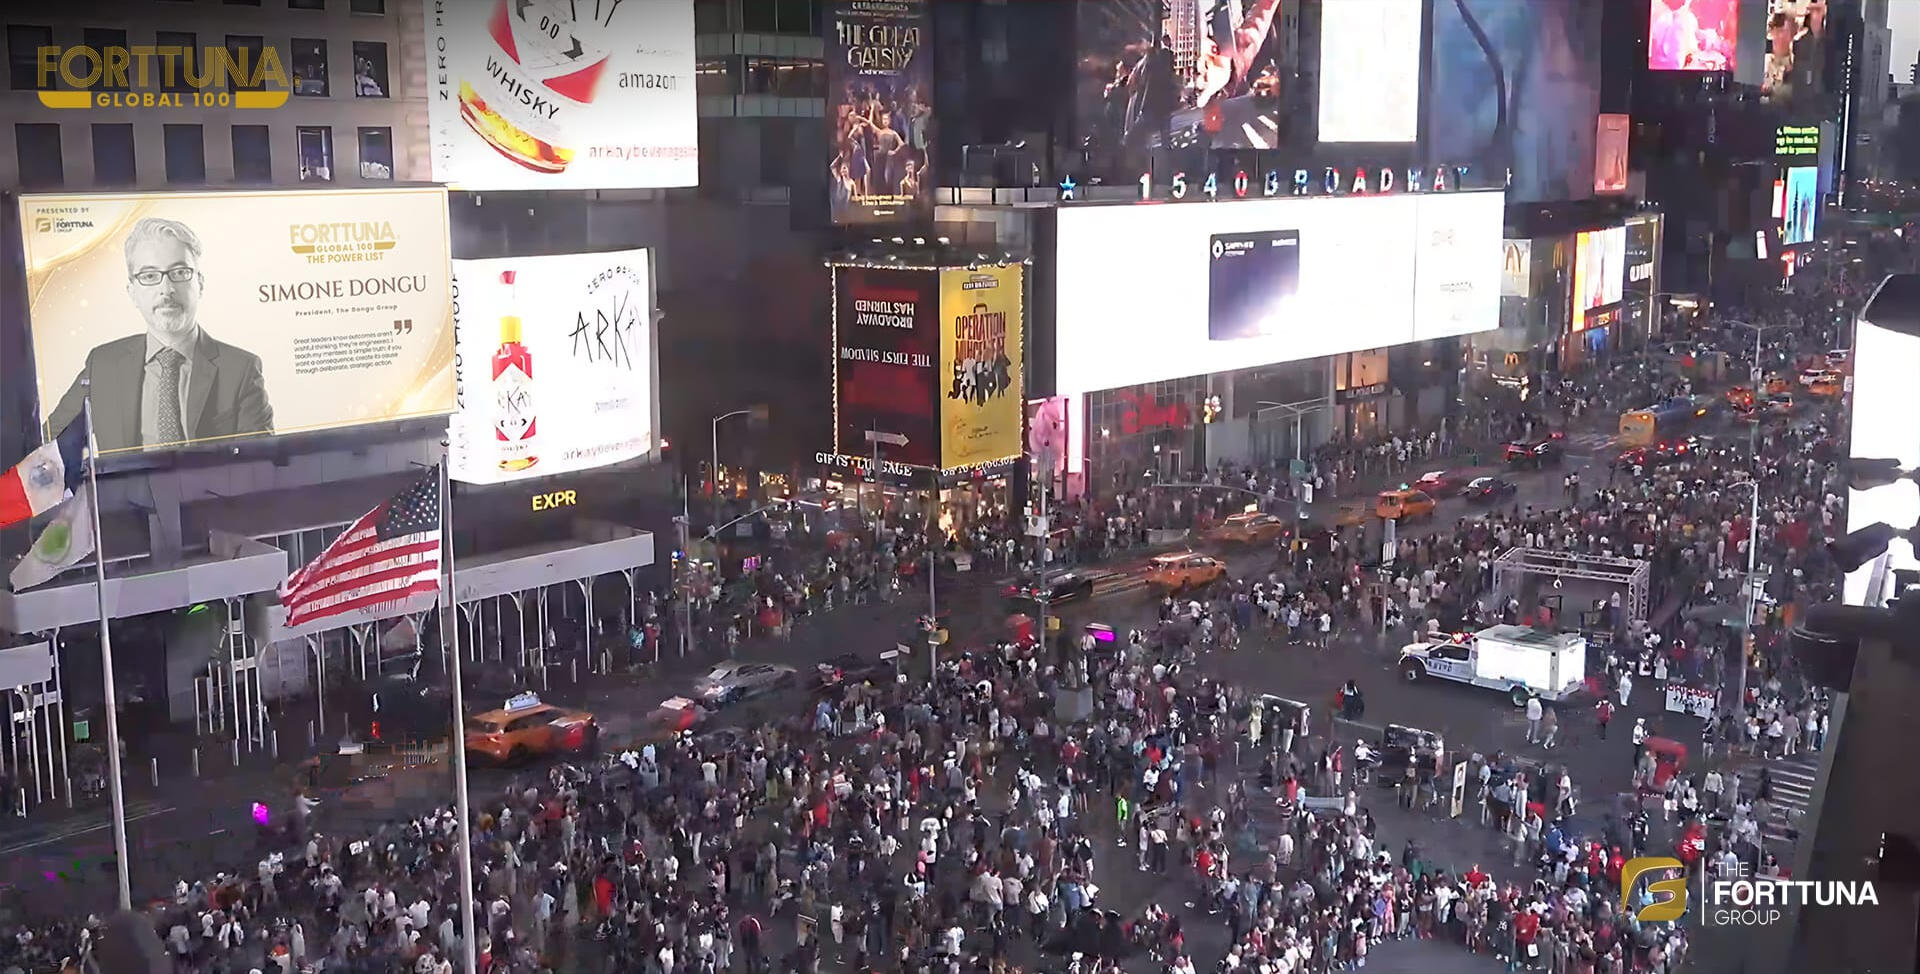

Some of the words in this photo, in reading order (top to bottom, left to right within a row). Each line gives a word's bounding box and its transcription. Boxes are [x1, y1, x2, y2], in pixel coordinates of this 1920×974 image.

[436, 36, 449, 101] ZERO
[486, 55, 560, 120] WHISKY
[618, 71, 677, 90] amazon
[1138, 169, 1249, 201] 1540
[289, 221, 396, 245] FORTTUNA
[316, 243, 354, 253] GLOBAL
[356, 242, 373, 251] 100
[306, 255, 325, 264] THE
[328, 253, 363, 263] POWER
[365, 252, 385, 261] LIST
[258, 280, 344, 303] SIMONE
[350, 275, 427, 297] DONGU
[295, 309, 333, 317] President,
[855, 300, 893, 314] TURNED
[893, 302, 915, 316] HAS
[856, 312, 913, 329] BROADWAY
[955, 311, 1006, 340] OPERATION
[310, 336, 332, 344] leaders
[353, 346, 371, 354] simple
[391, 344, 402, 352] you
[881, 350, 908, 365] FIRST
[295, 367, 318, 375] through
[815, 452, 849, 468] GIFTS
[856, 457, 913, 477] LUGAGE
[532, 490, 577, 511] EXPR
